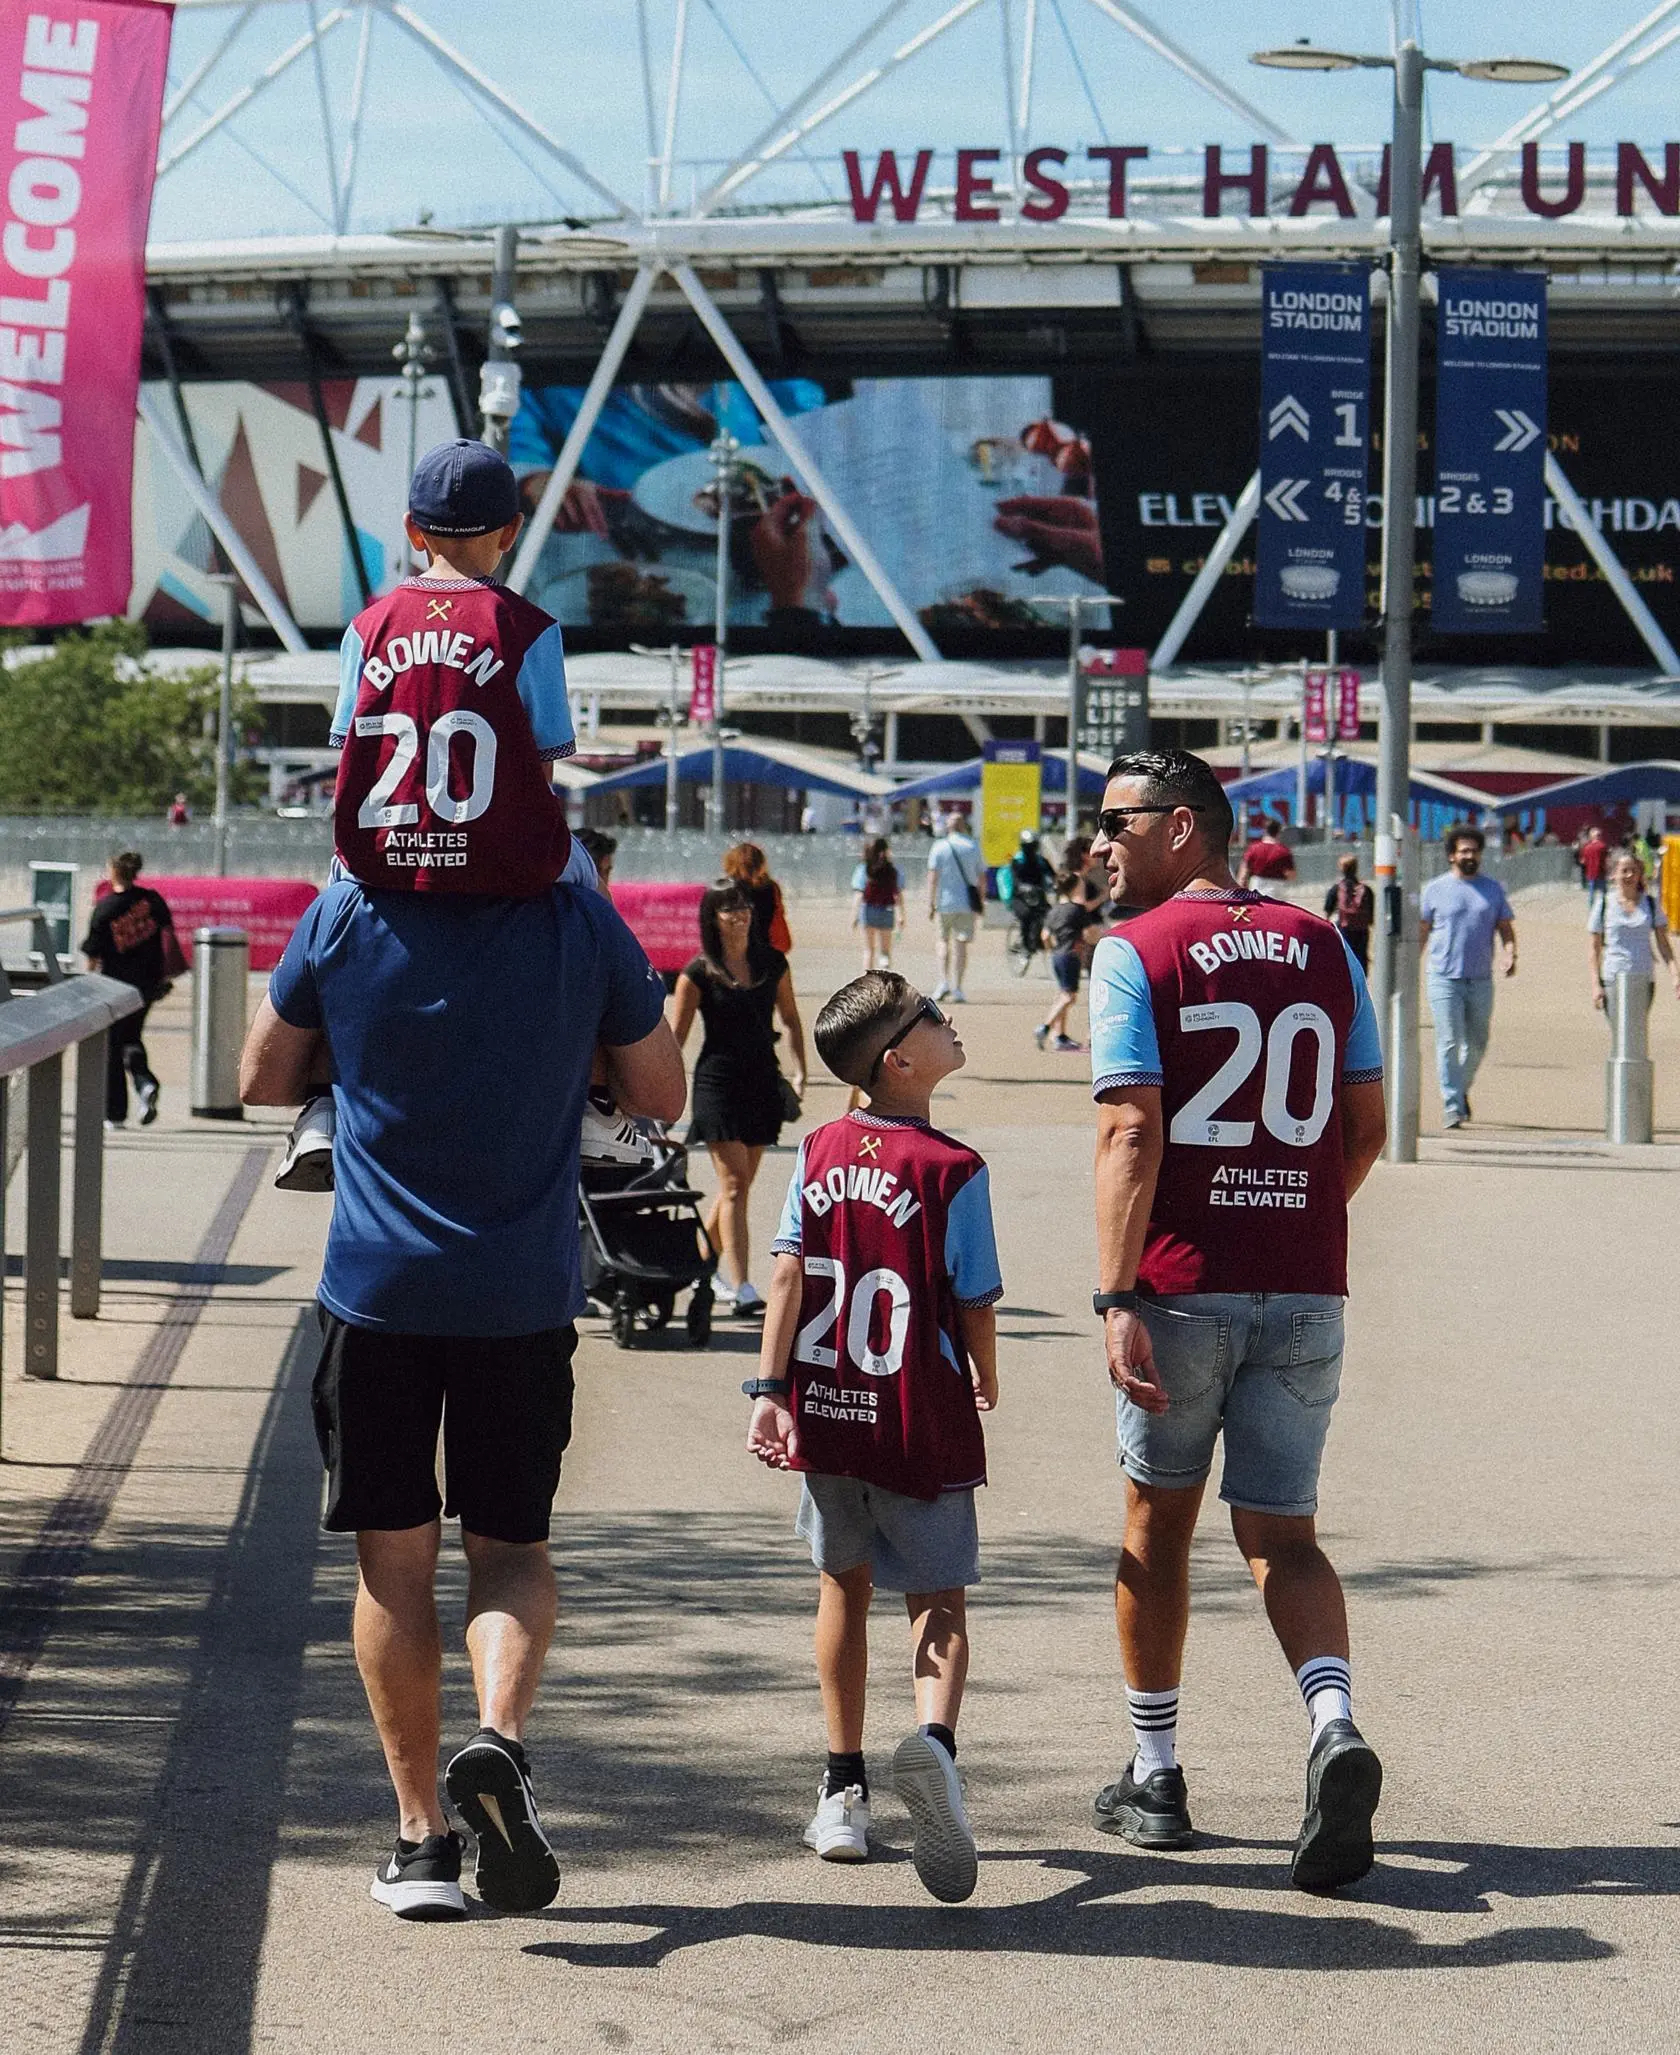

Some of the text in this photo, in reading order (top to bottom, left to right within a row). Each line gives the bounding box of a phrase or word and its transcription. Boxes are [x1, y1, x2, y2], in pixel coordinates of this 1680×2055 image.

[843, 143, 1680, 222] WEST HAM UN
[0, 14, 98, 478] WELCOME
[1269, 291, 1363, 313] LONDON
[1445, 299, 1539, 320] LONDON
[1270, 311, 1362, 332] STADIUM
[1445, 319, 1538, 339] STADIUM
[1331, 389, 1365, 400] BRIDGE
[1334, 403, 1363, 448] 1
[1323, 468, 1364, 479] BRIDGES
[1440, 471, 1481, 482] BRIDGES
[1323, 481, 1362, 504] 4 &
[1438, 486, 1462, 514] 2
[1466, 493, 1488, 514] &
[1491, 487, 1515, 515] 3
[1138, 493, 1245, 527] ELEV
[1344, 503, 1362, 526] 5
[454, 525, 486, 533] ARMOUR
[1287, 548, 1335, 560] LONDON
[1464, 554, 1513, 566] LONDON
[363, 629, 505, 692] BOWEN
[355, 710, 498, 829] 20
[384, 830, 468, 848] ATHLETES
[386, 852, 468, 868] ELEVATED
[1188, 929, 1309, 975] BOWEN
[1170, 1001, 1336, 1147] 20
[1211, 1165, 1309, 1188] ATHLETES
[801, 1164, 922, 1229] BOWEN
[1209, 1189, 1307, 1209] ELEVATED
[794, 1256, 911, 1376] 20
[805, 1381, 879, 1407] ATHLETES
[804, 1401, 877, 1425] ELEVATED
